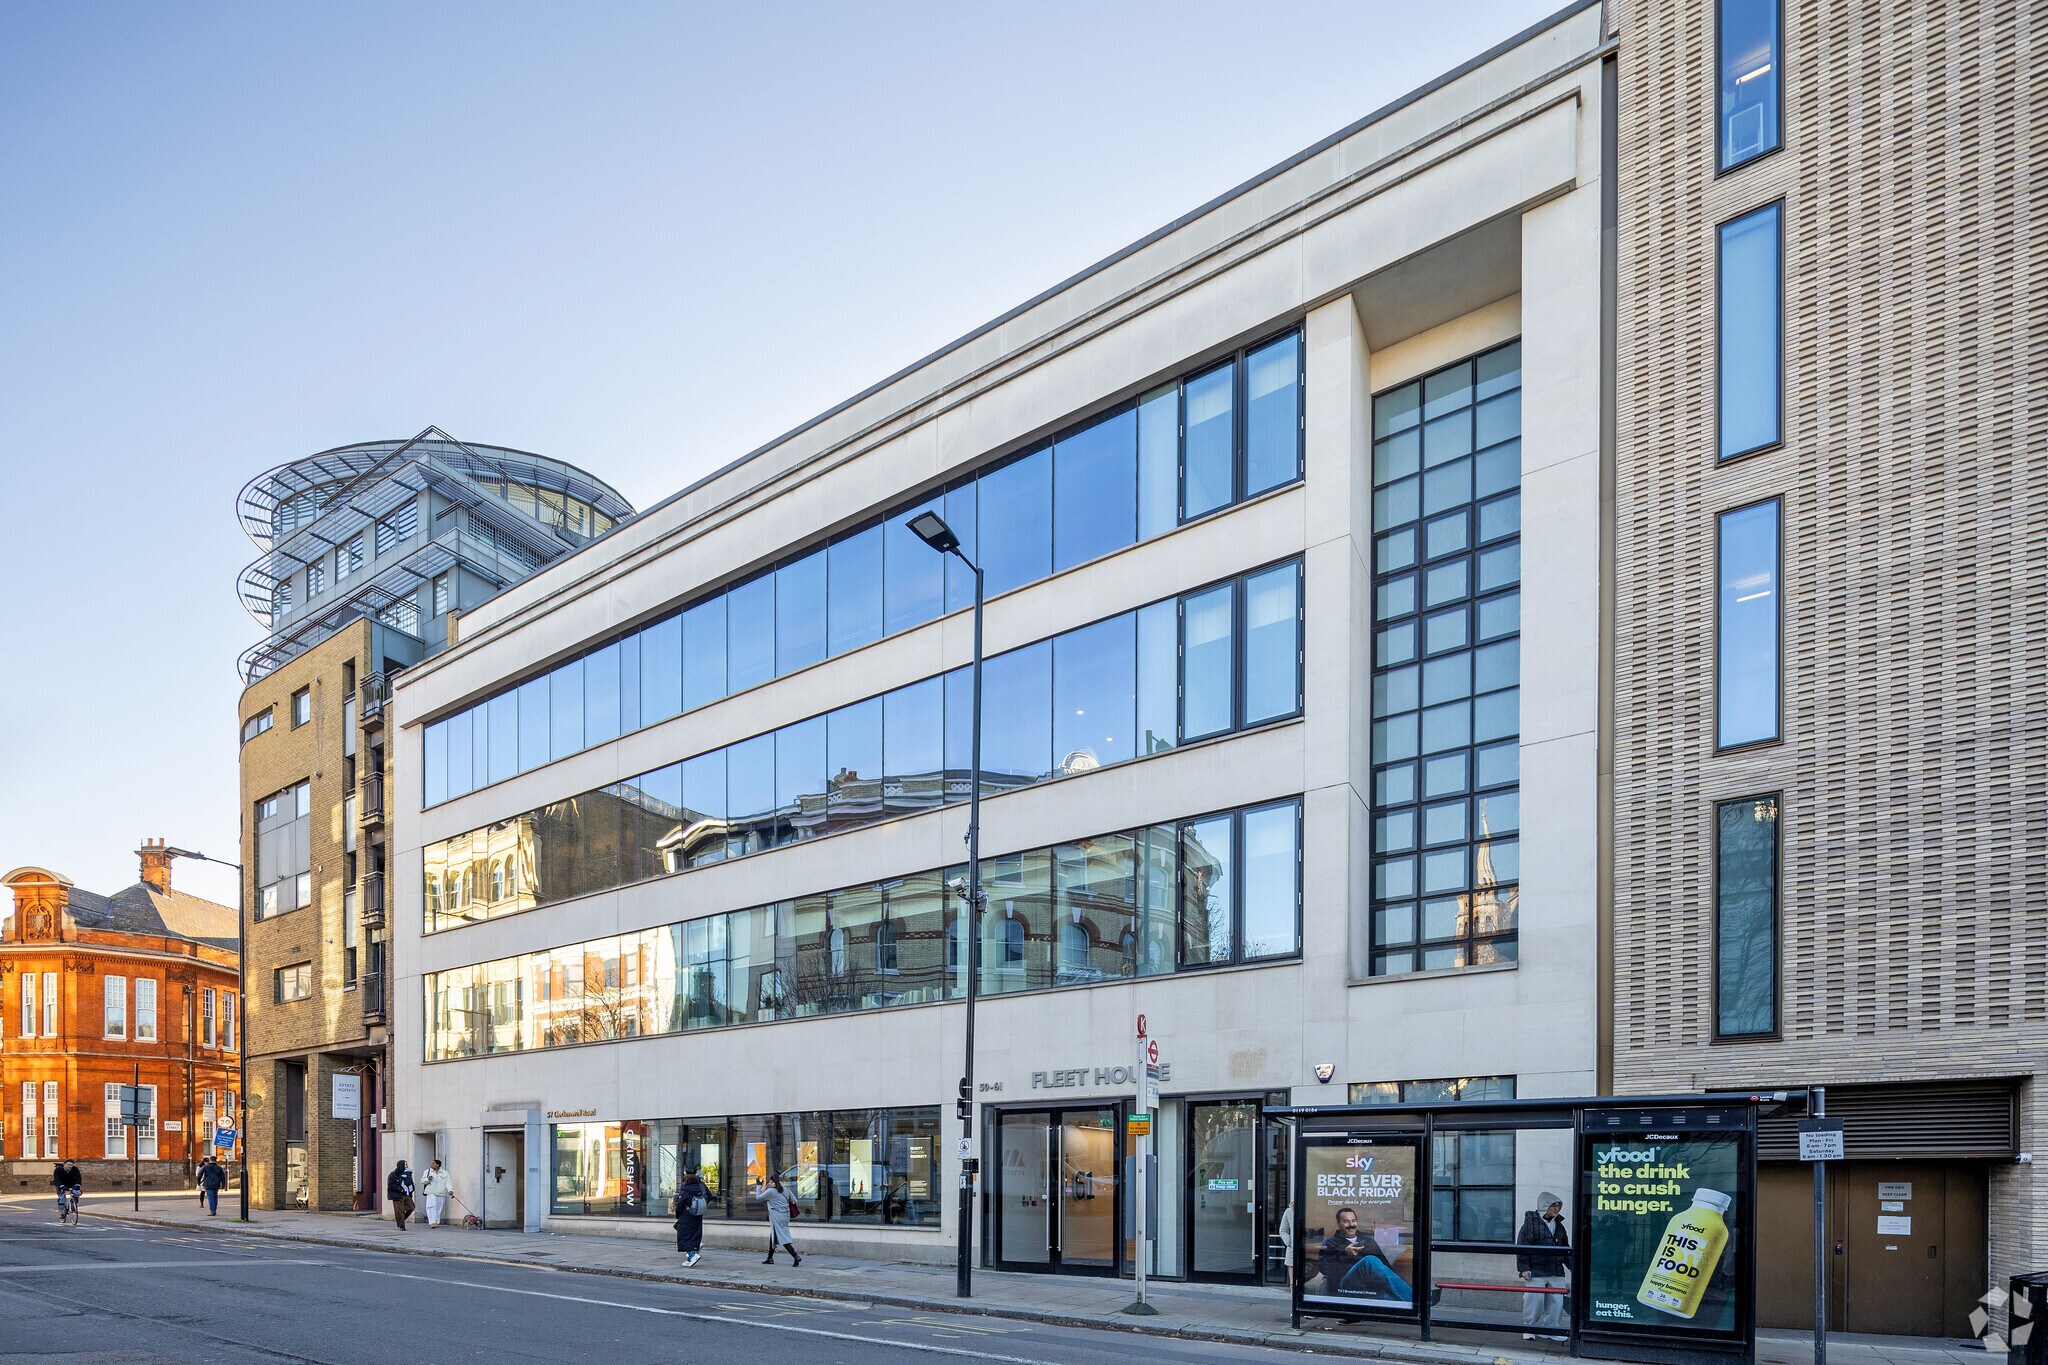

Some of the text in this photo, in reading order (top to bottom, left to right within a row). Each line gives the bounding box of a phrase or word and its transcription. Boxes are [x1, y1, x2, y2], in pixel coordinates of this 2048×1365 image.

[1140, 1016, 1146, 1032] K
[1032, 1063, 1170, 1088] FLEET HOUE
[1346, 1155, 1373, 1170] sky
[1598, 1147, 1655, 1164] yfood
[1598, 1163, 1690, 1178] the drink
[1317, 1174, 1402, 1187] BEST EVER
[1598, 1180, 1680, 1195] to crush
[1317, 1187, 1401, 1197] BLACK FRIDAY
[1598, 1195, 1673, 1214] hunger.
[1681, 1224, 1705, 1233] yfood
[1667, 1234, 1698, 1250] THIS
[1662, 1246, 1676, 1257] IS
[1657, 1258, 1699, 1278] FOOD
[1666, 1284, 1686, 1294] banana
[1596, 1301, 1630, 1311] hunger,
[1613, 1310, 1633, 1318] this.
